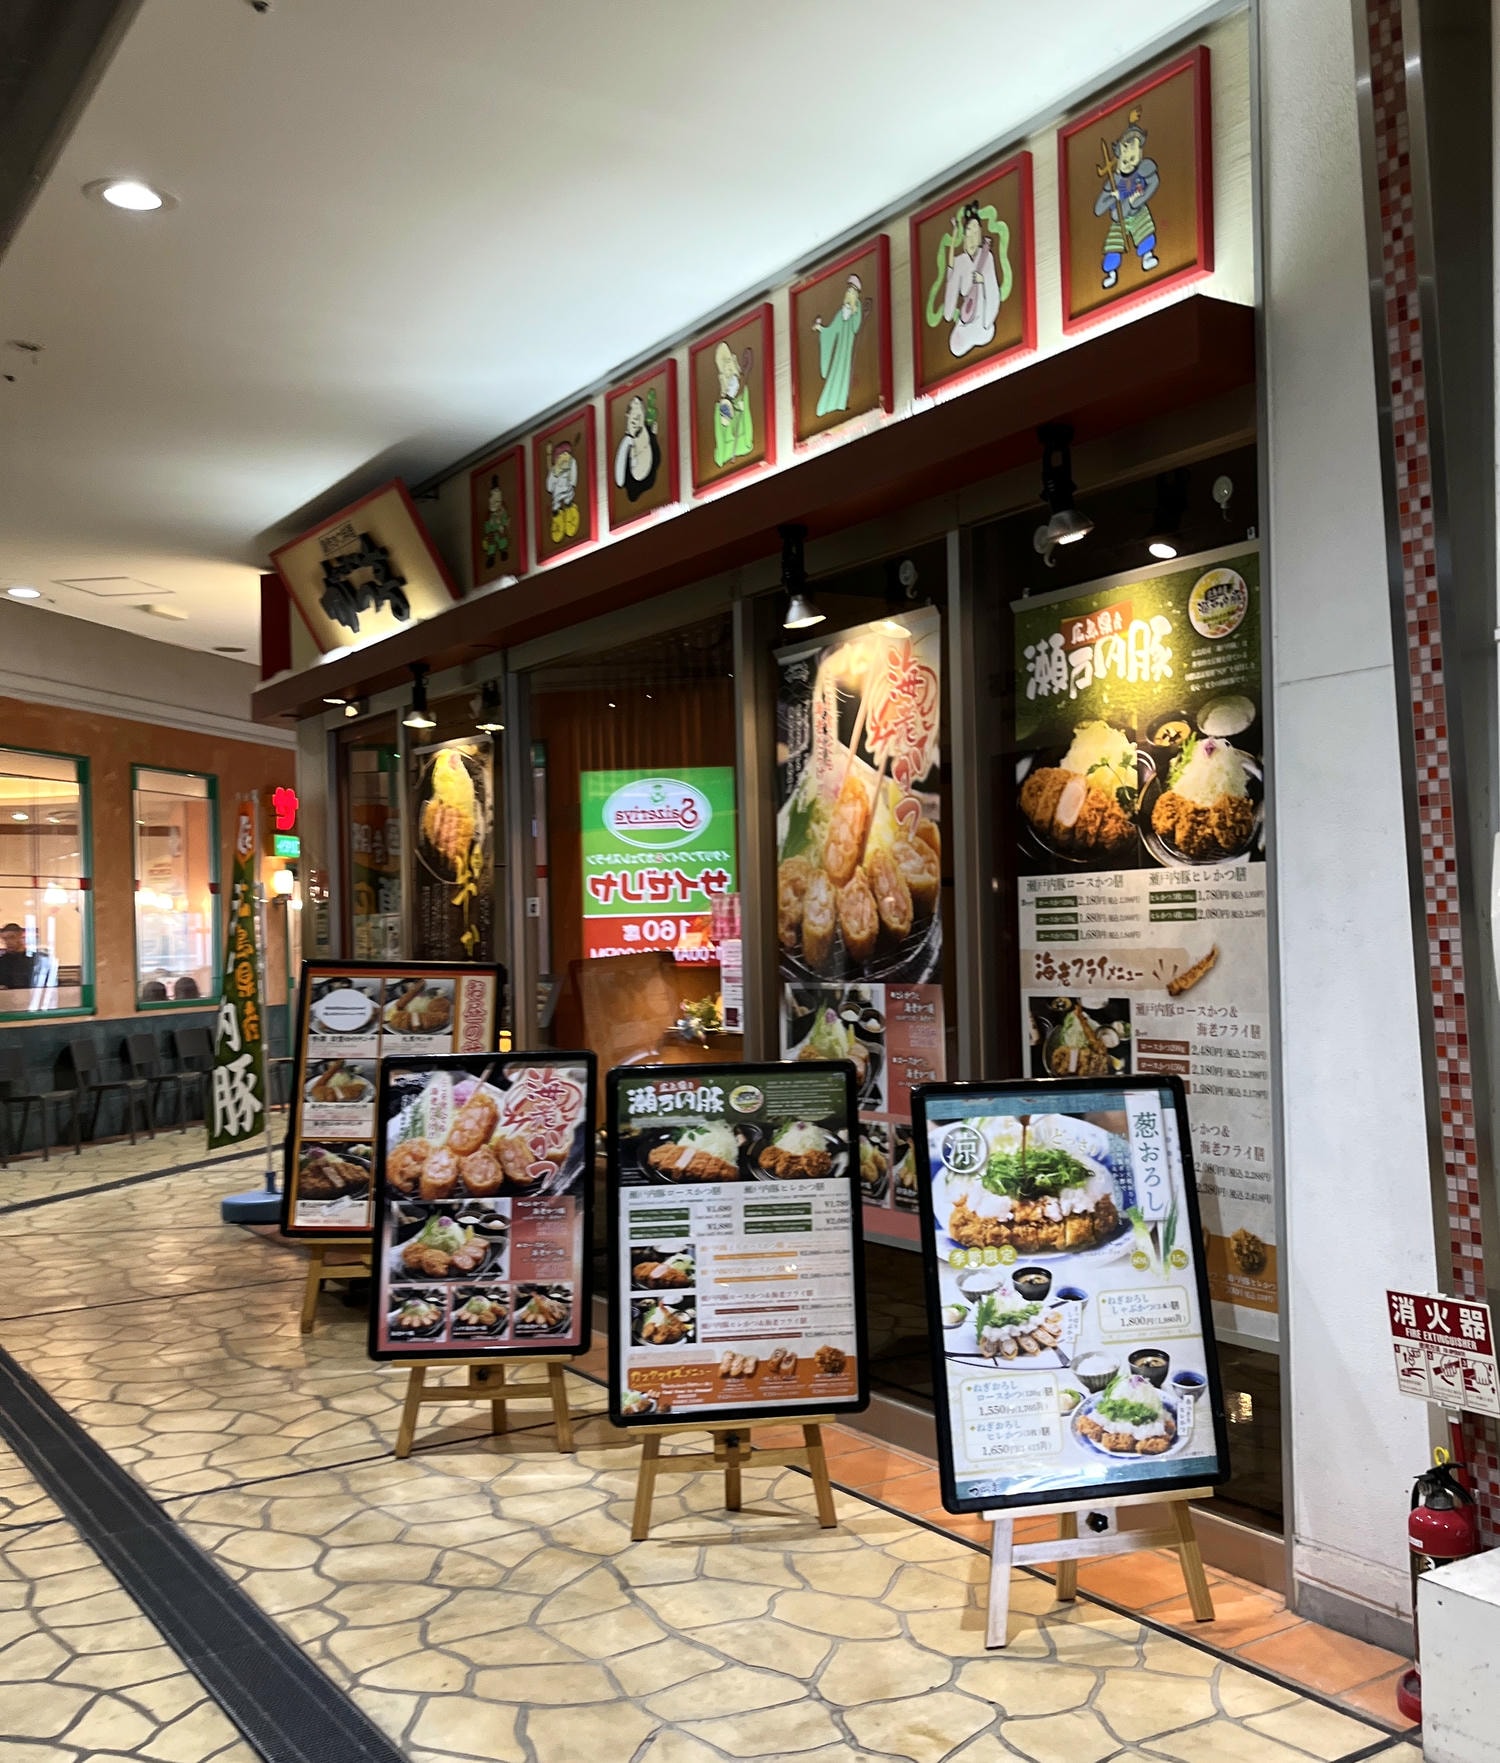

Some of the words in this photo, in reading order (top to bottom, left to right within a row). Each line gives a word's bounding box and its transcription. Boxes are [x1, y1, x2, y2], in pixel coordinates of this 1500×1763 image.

[1023, 614, 1173, 700] 瀬戸内豚
[626, 1085, 725, 1116] 瀬戸内豚
[945, 1131, 980, 1167] 涼
[1133, 1111, 1165, 1212] 葱おろし
[1390, 1294, 1486, 1342] 消火器
[1405, 1327, 1422, 1340] FIRE
[1423, 1330, 1478, 1351] EXTINGUISHER
